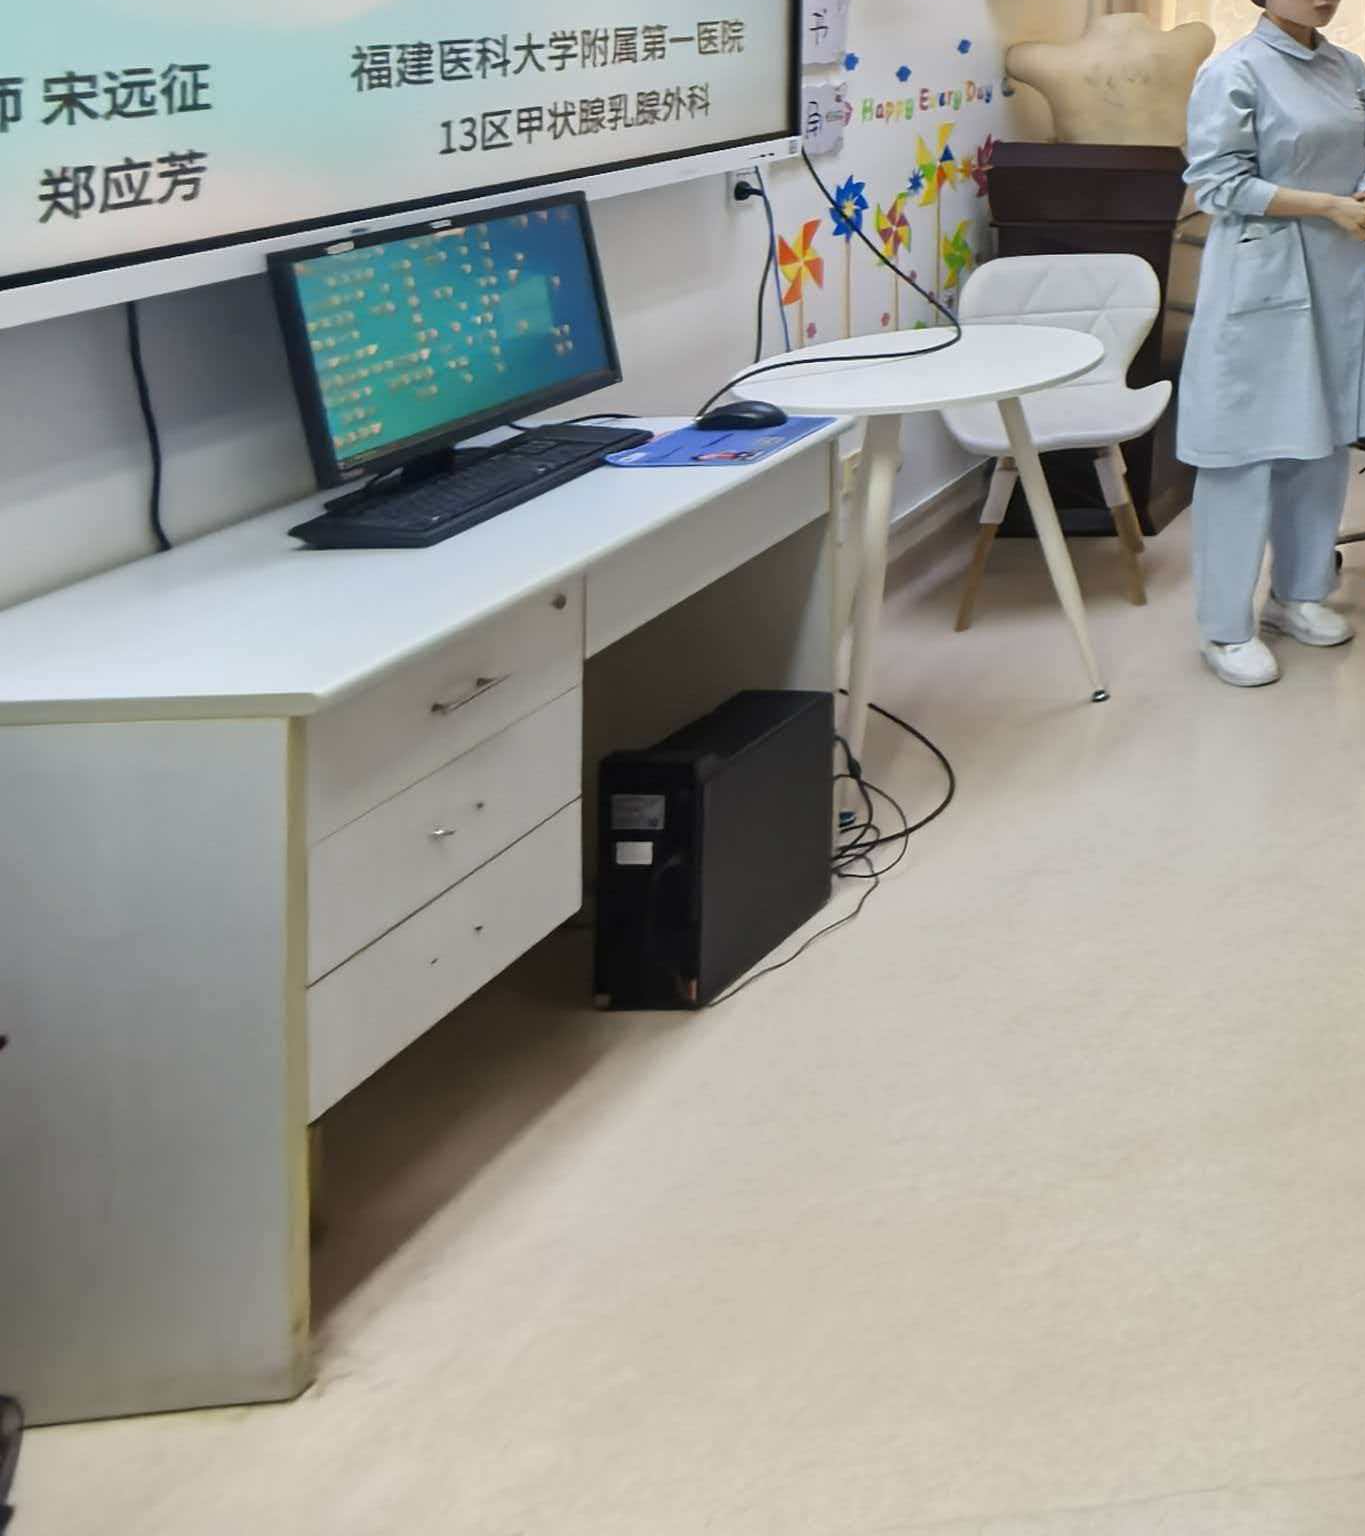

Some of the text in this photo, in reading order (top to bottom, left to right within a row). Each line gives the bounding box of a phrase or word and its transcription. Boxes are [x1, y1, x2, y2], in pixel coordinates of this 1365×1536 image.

[350, 19, 745, 92] 福建医科大学附属第一医院
[41, 64, 212, 125] 宋远征
[438, 82, 711, 155] 13区甲状腺乳腺外科
[39, 149, 208, 224] 郑应芳
